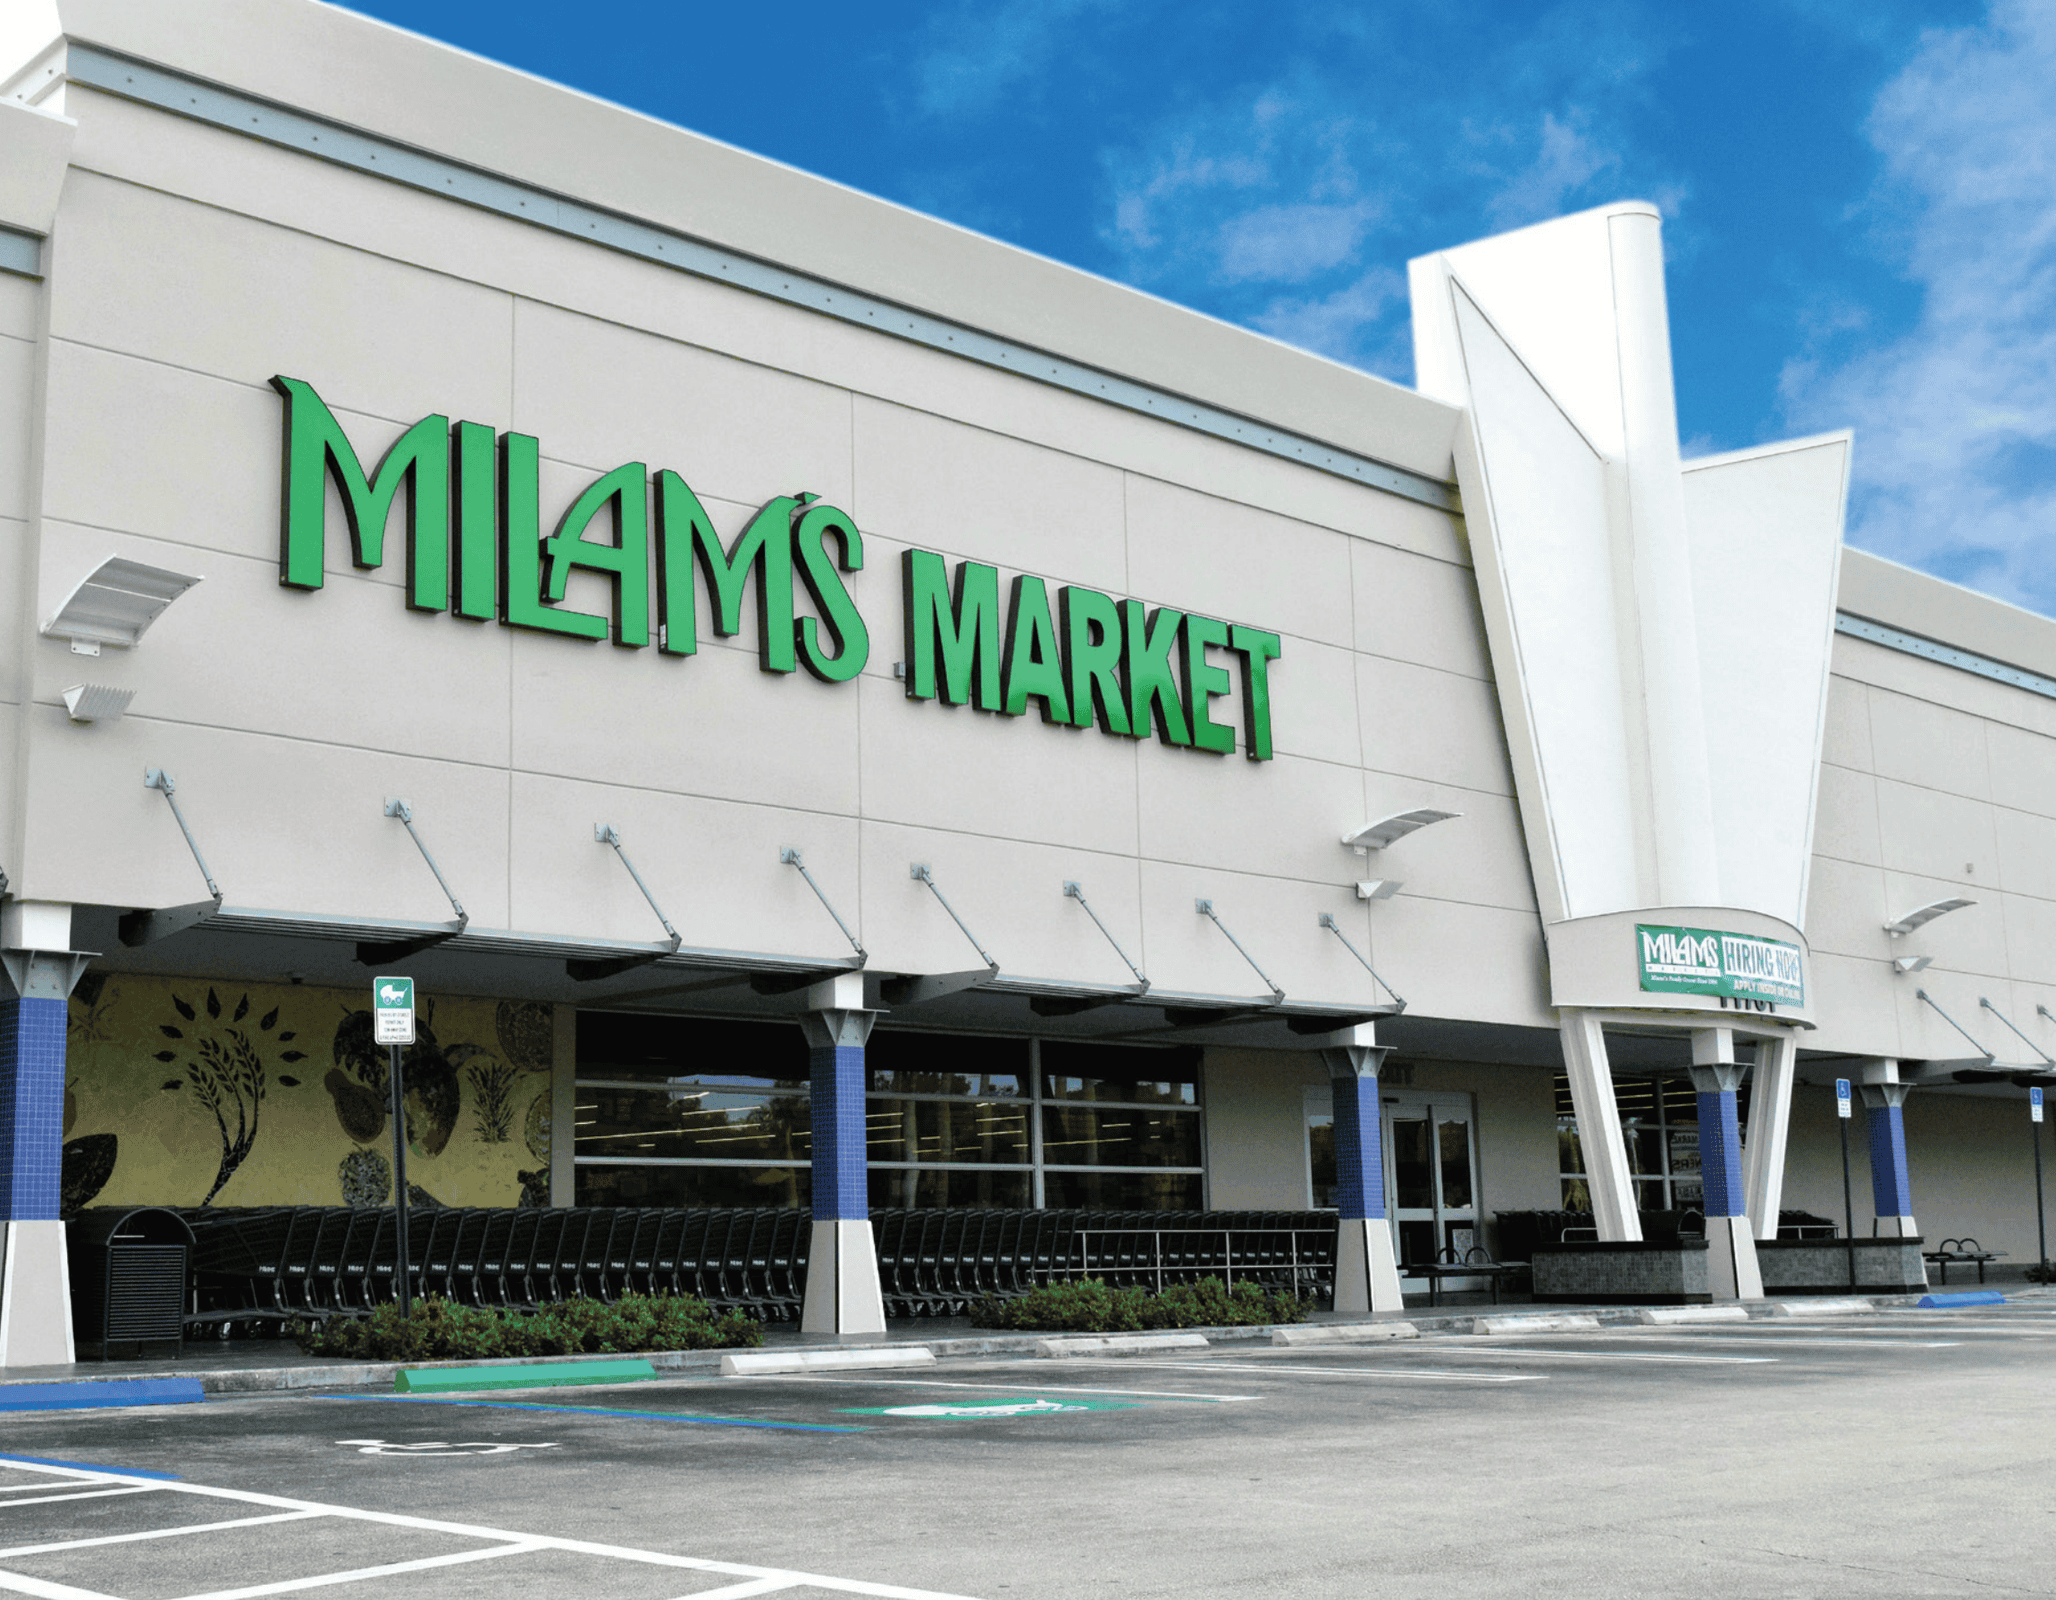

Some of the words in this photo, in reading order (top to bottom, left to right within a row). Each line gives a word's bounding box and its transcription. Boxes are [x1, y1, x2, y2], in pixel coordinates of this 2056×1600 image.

[267, 375, 870, 683] MILAM'S
[902, 548, 1281, 762] MARKET
[1724, 941, 1774, 977] HIRING
[1734, 979, 1756, 992] APPLY
